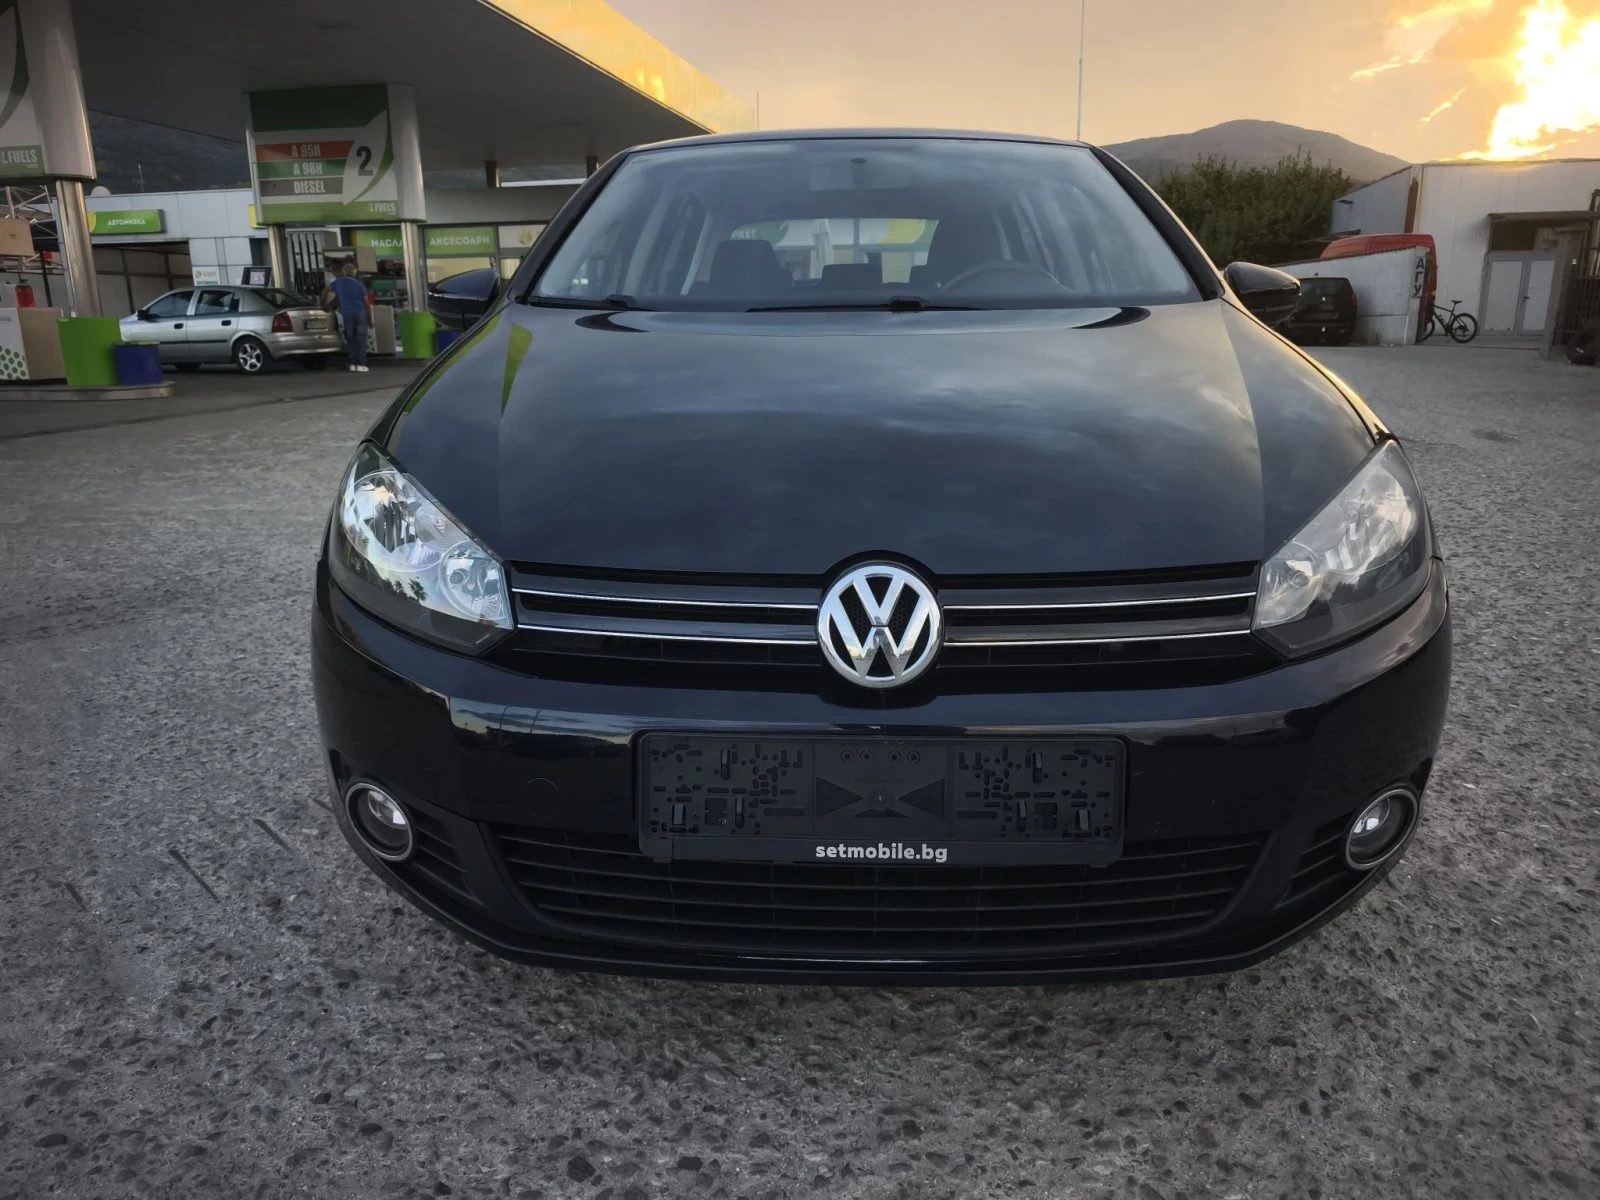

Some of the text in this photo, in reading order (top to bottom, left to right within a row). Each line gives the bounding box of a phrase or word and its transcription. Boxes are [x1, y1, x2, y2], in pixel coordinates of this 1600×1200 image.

[356, 145, 374, 176] 2
[293, 180, 326, 194] DIESEL
[107, 218, 147, 226] АВТОМИВКА
[815, 842, 948, 863] setmobile.bg
